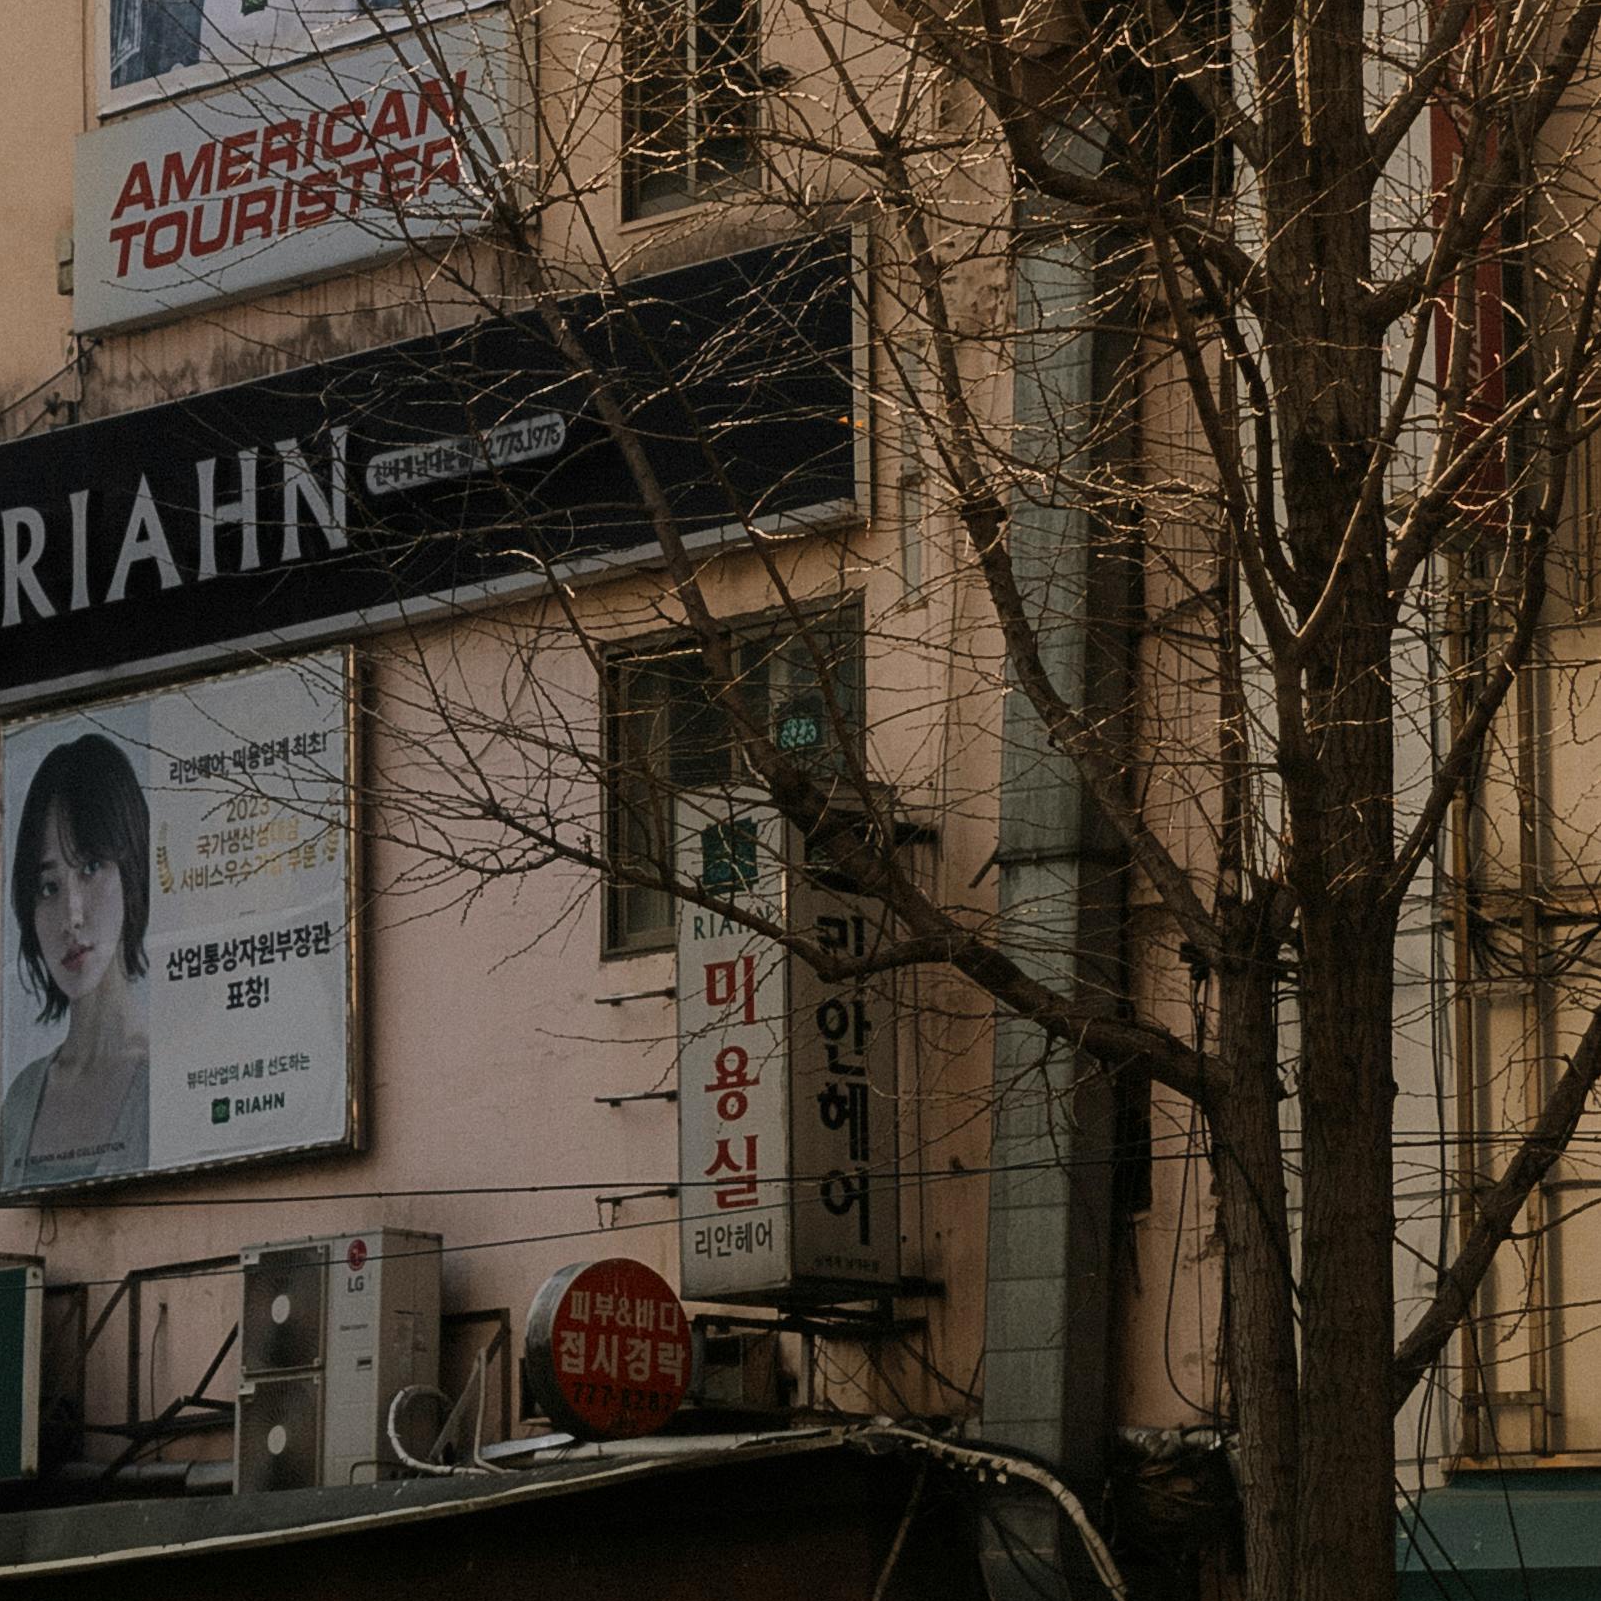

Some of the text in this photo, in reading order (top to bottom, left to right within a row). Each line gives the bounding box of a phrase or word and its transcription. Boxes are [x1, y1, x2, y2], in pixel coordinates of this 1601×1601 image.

[111, 70, 467, 220] AMERICAN
[109, 135, 462, 277] TOURISTER
[1, 424, 349, 629] RIAHN
[291, 731, 327, 756] 최초!
[226, 798, 271, 823] 2023
[166, 921, 330, 981] 산업통상자원부장관
[226, 975, 269, 1010] 표창!
[187, 1063, 239, 1089] 뷰티산업의
[268, 1053, 310, 1075] 선도하는
[704, 954, 760, 1209] 미용실
[817, 914, 871, 1246] 리안헤어
[235, 1092, 285, 1116] RIAHN
[695, 1218, 773, 1259] 리안헤어
[348, 1276, 364, 1293] LG
[569, 1290, 679, 1336] 피부&바디
[559, 1330, 686, 1387] 접시경락
